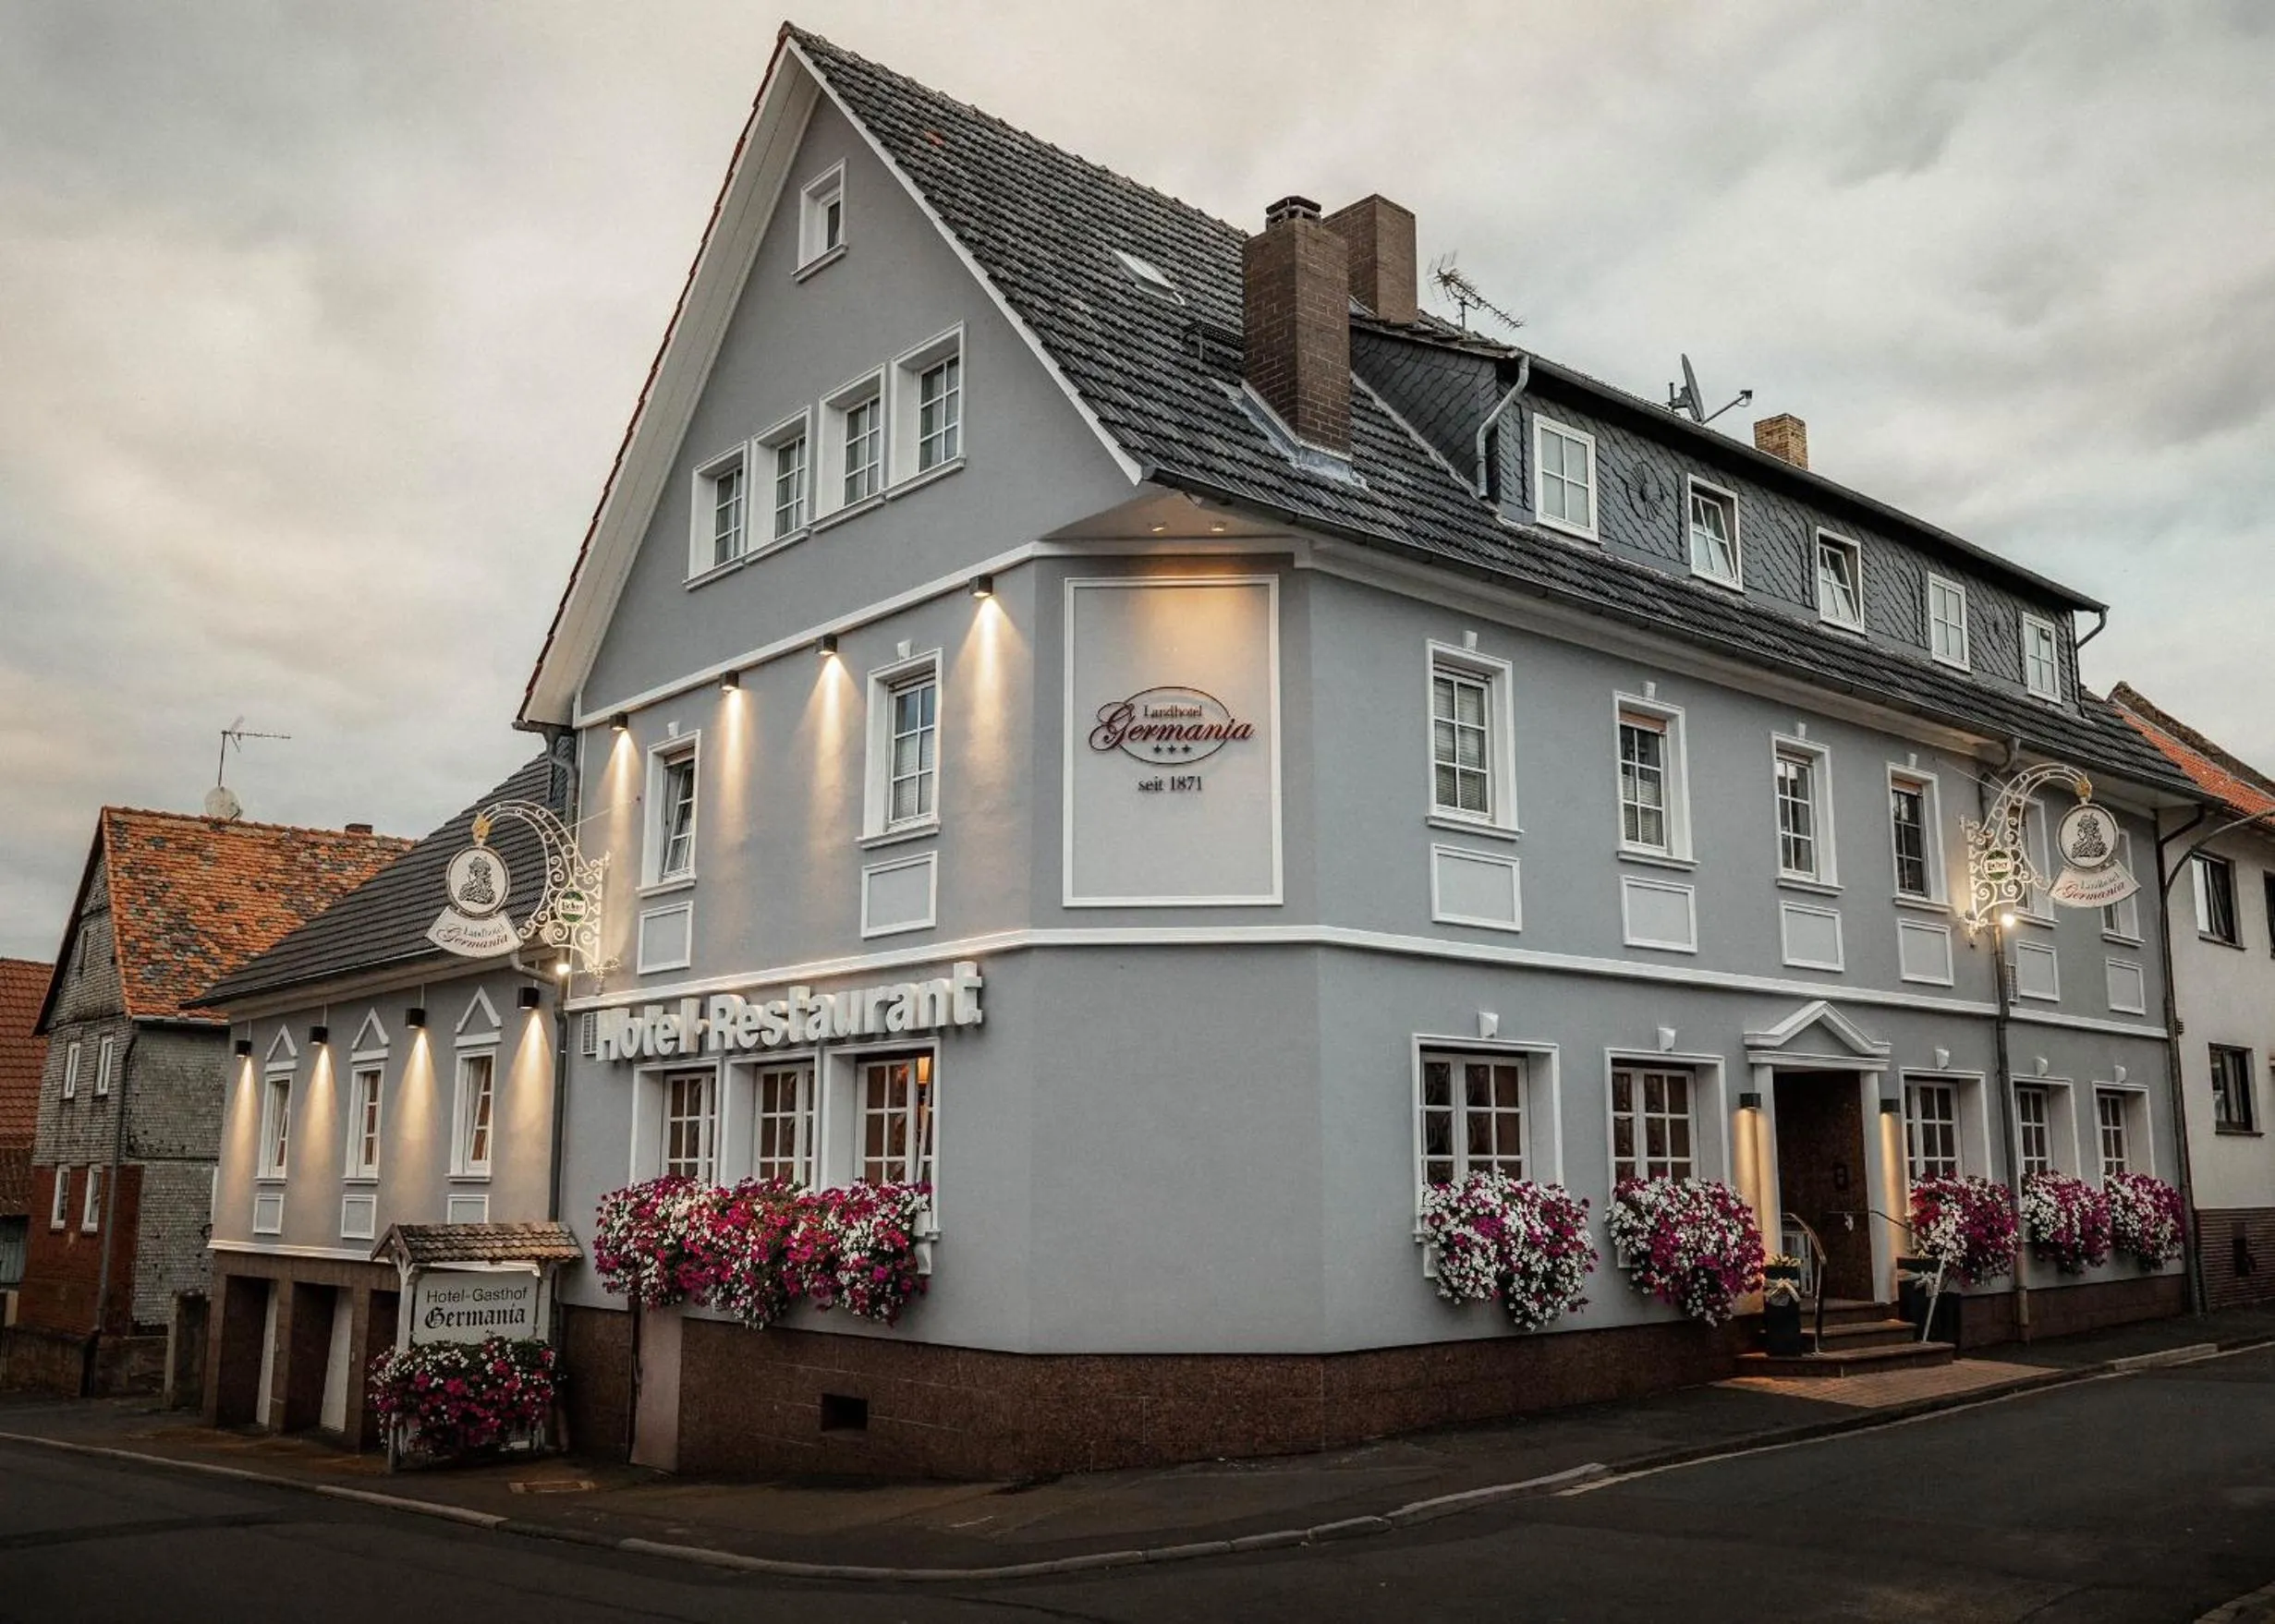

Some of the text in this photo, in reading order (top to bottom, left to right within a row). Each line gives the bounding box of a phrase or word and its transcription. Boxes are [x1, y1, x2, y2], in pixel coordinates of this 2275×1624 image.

[1144, 705, 1202, 719] Landhotel
[1089, 701, 1255, 751] Germania
[1138, 776, 1203, 792] seit 1871
[2054, 879, 2124, 901] Germania
[436, 923, 507, 948] Germania
[427, 1286, 528, 1303] Hotel-Gasthof
[425, 1303, 526, 1329] Germania
